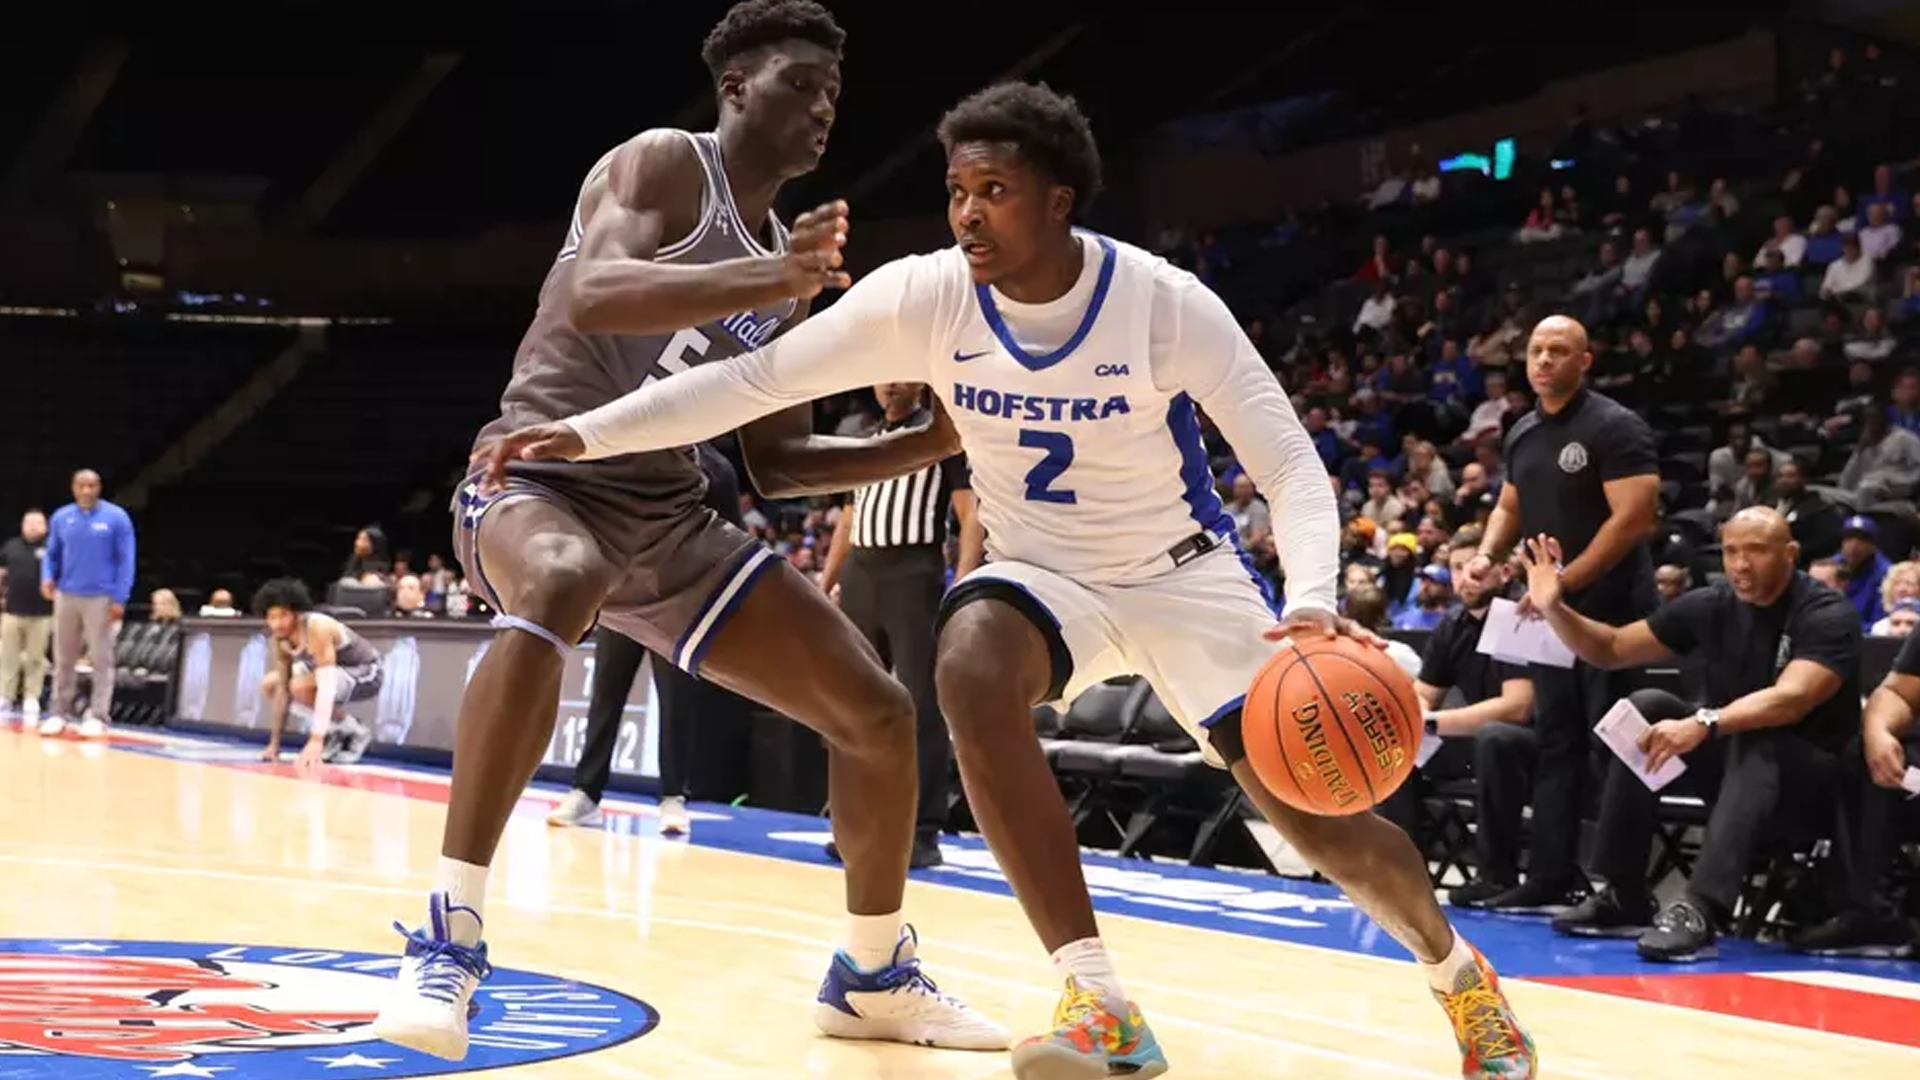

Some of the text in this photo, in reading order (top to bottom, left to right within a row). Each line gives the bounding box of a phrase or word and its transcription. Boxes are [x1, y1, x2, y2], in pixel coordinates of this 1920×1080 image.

[954, 382, 1131, 421] HOFSTRA
[1095, 364, 1130, 377] CAA
[1018, 428, 1077, 504] 2
[1342, 691, 1394, 783] LEGACY
[206, 946, 622, 1050] LON ISLAND
